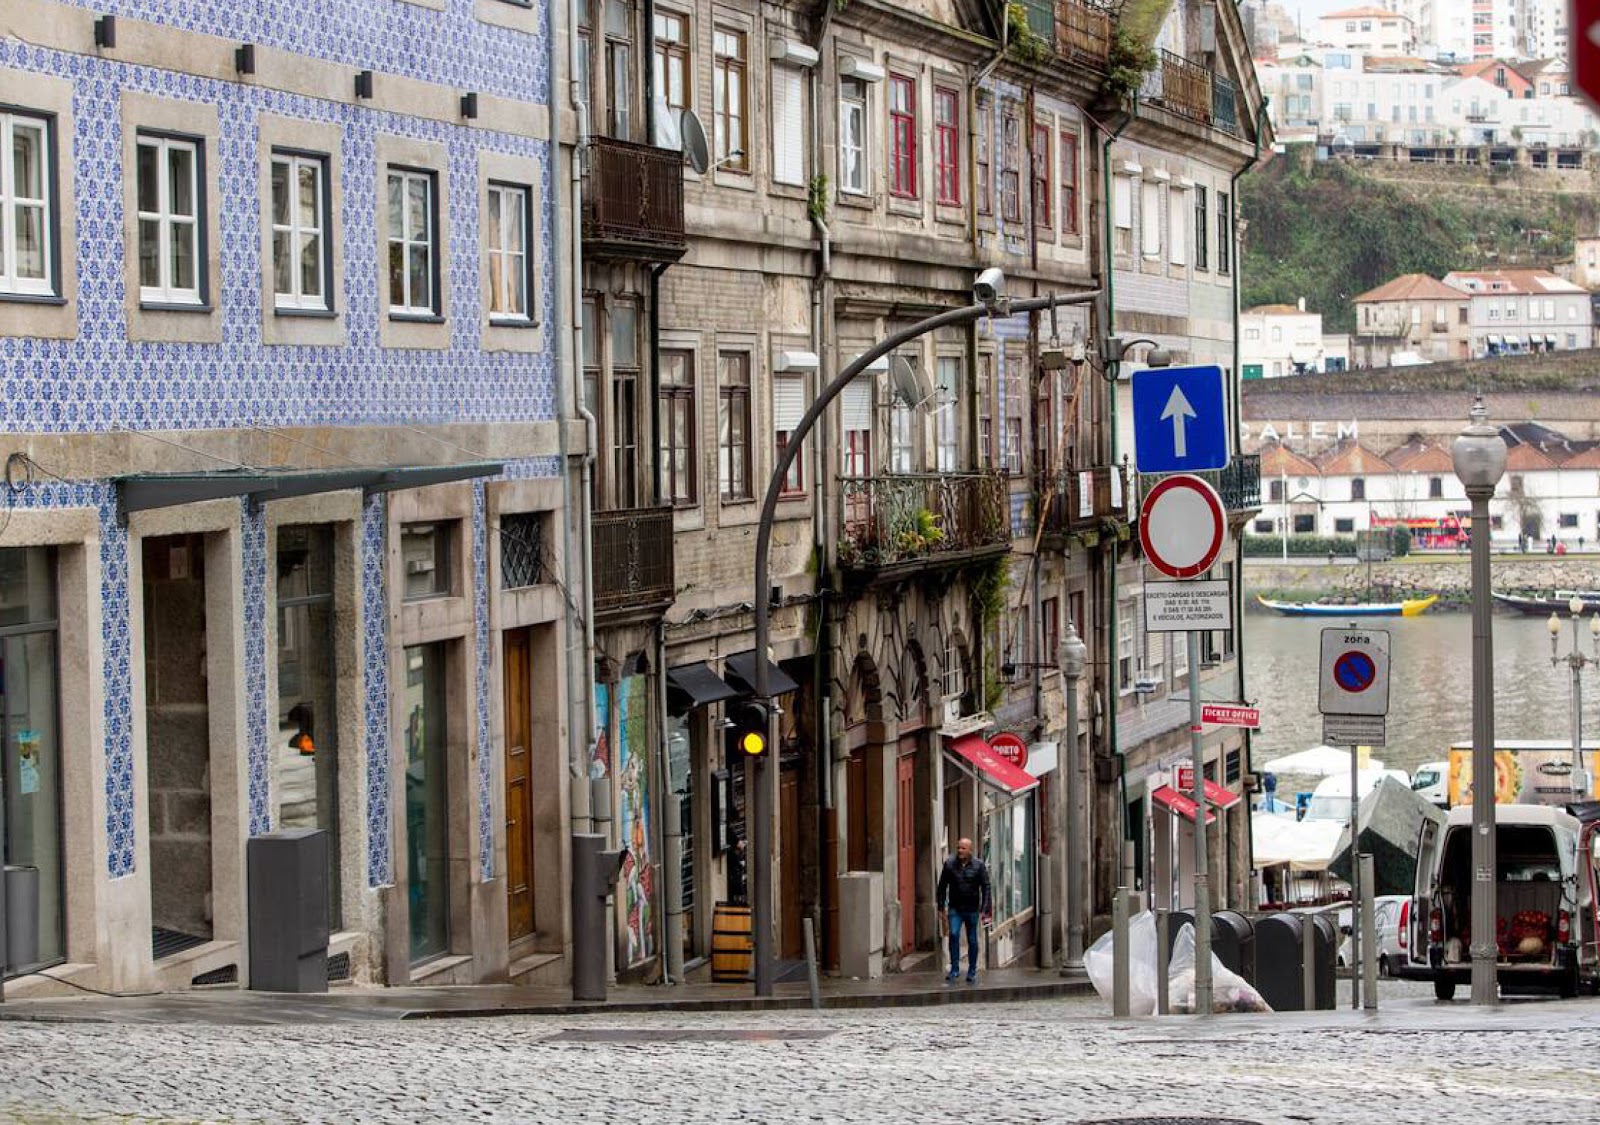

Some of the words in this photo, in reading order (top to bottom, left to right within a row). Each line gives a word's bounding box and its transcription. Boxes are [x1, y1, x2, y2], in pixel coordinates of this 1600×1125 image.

[1344, 635, 1370, 644] zona
[1204, 708, 1231, 717] TICKET
[1231, 710, 1258, 720] OFFICE
[992, 745, 1019, 756] PORTO
